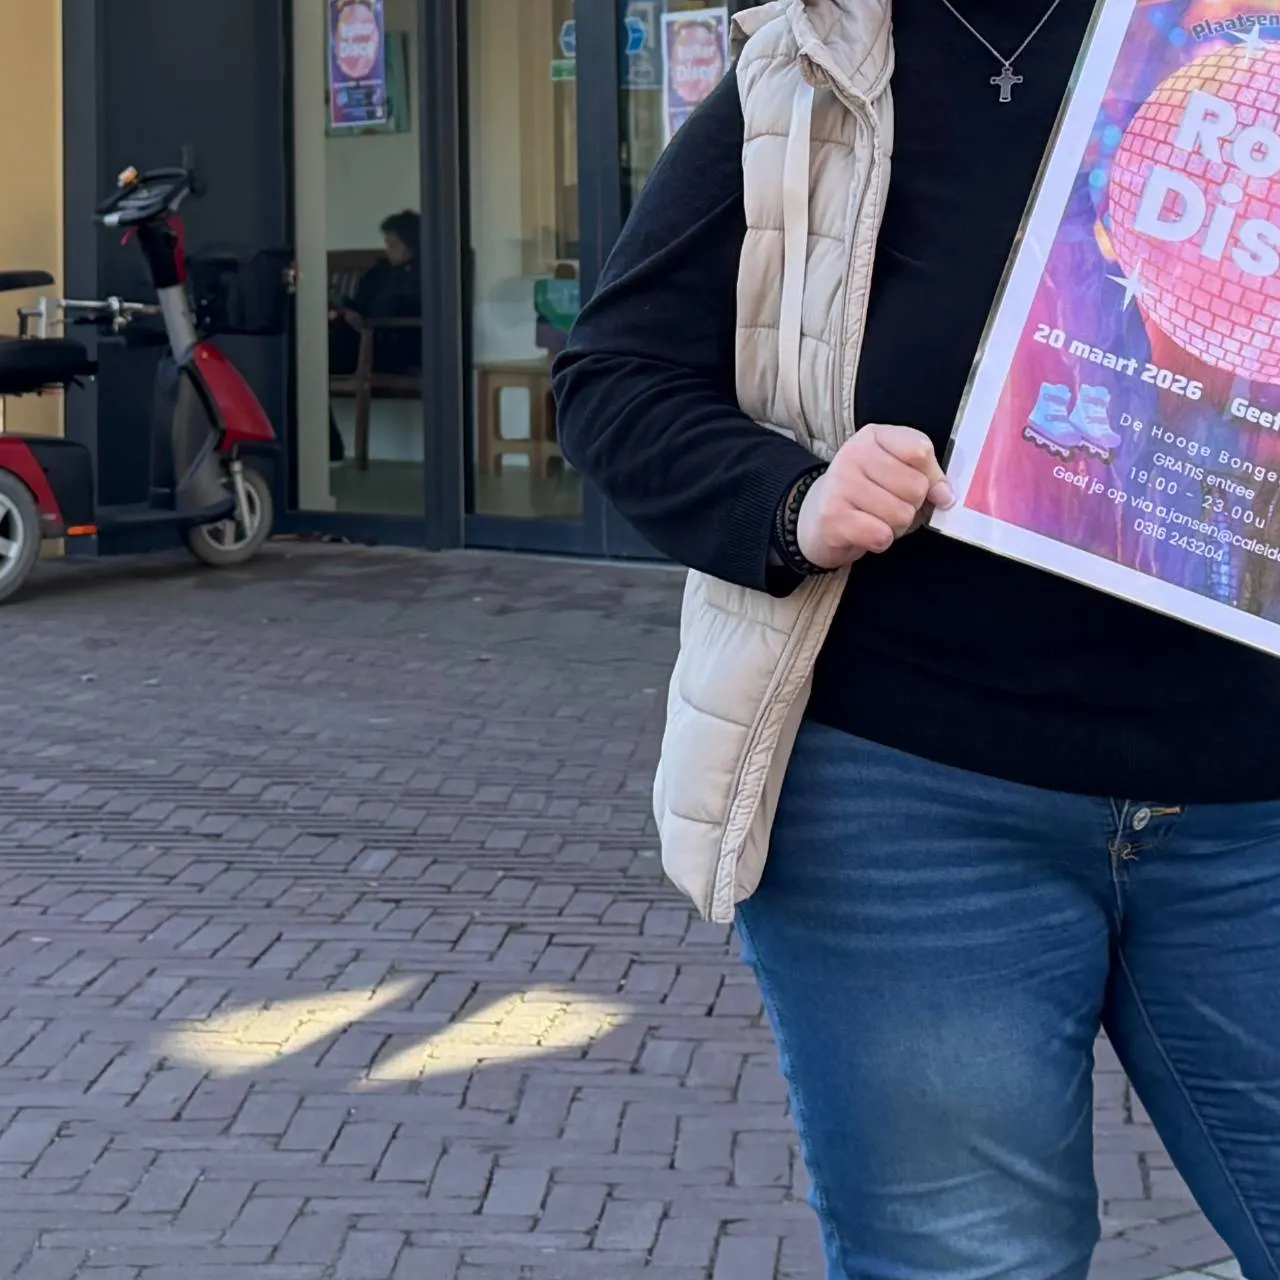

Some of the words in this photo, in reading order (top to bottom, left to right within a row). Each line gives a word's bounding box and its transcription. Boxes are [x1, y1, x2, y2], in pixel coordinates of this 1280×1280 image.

[1192, 13, 1280, 40] Plaatsen
[1033, 323, 1066, 349] 20
[1070, 339, 1138, 377] maart
[1140, 363, 1204, 401] 2026
[1119, 412, 1143, 432] De
[1151, 425, 1211, 457] Hooge
[1087, 477, 1105, 494] je
[1107, 487, 1128, 504] op
[1131, 495, 1153, 512] via
[1130, 466, 1178, 495] 19.00
[1202, 495, 1266, 529] 23.00u
[1153, 452, 1205, 481] GRATIS
[1206, 474, 1255, 500] entree
[1133, 518, 1167, 540] 0316
[1168, 531, 1224, 562] 243204
